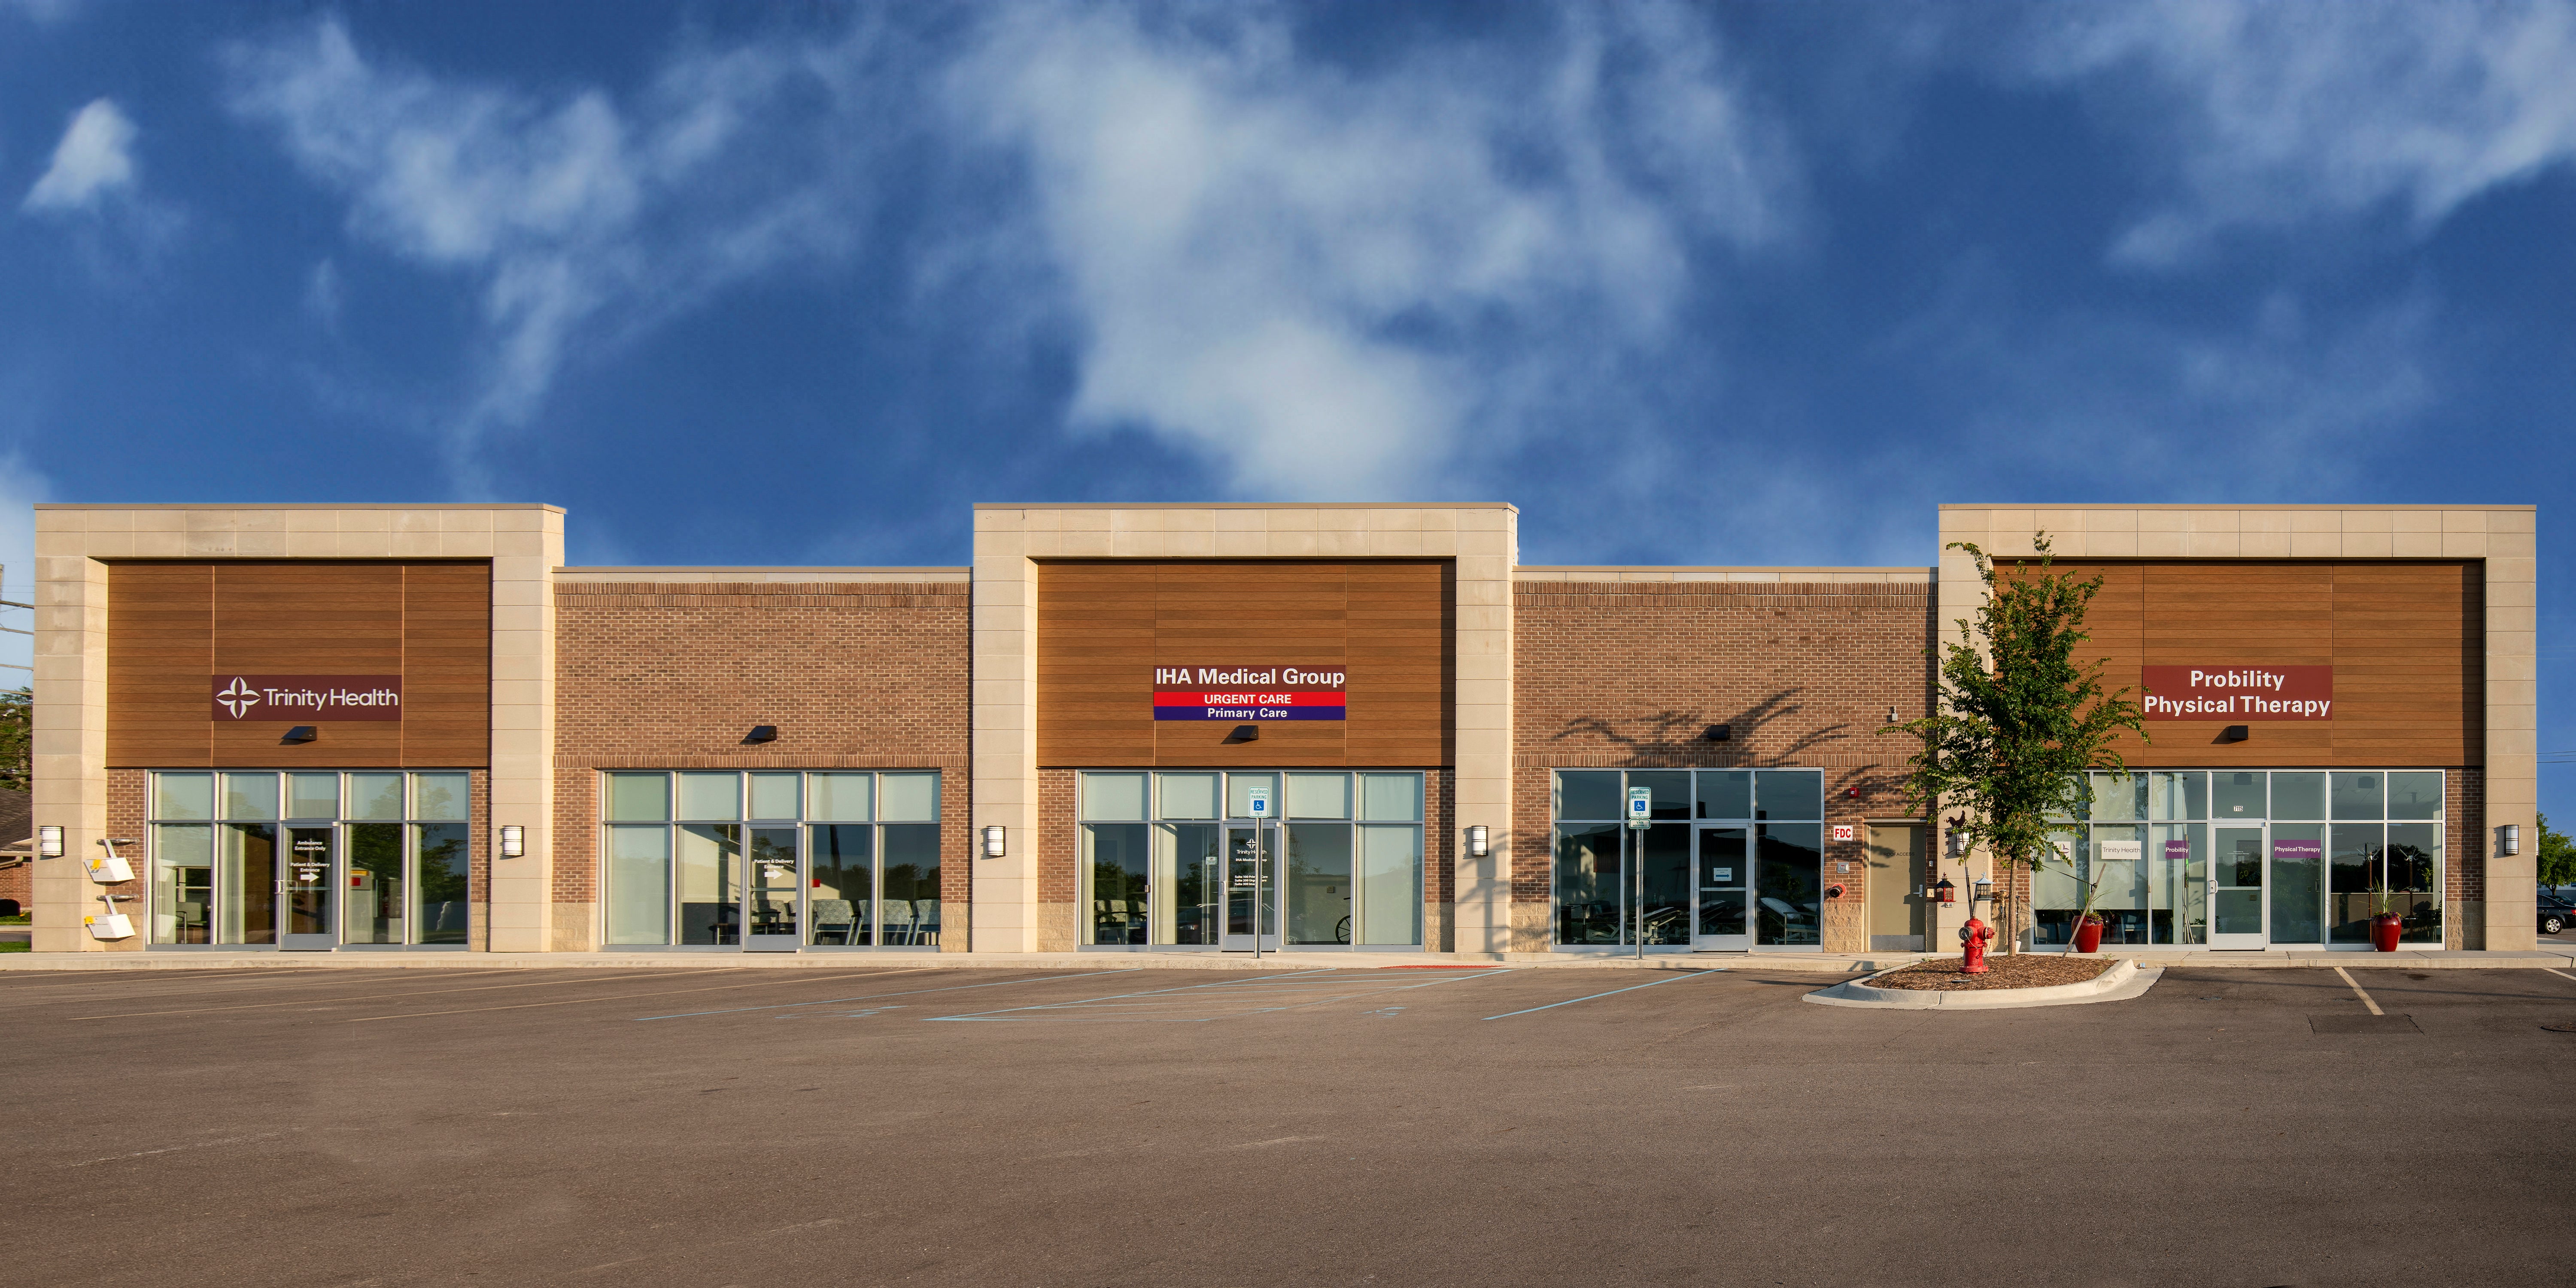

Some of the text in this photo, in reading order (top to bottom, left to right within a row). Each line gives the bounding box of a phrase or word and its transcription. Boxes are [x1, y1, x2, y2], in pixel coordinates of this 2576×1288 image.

[1156, 668, 1345, 688] IHA Medical Group
[2190, 670, 2285, 691] Probility
[263, 688, 398, 711] Trinity Health
[1204, 694, 1292, 704] URGENT CARE
[2145, 696, 2331, 717] Physical Therapy
[1207, 708, 1288, 720] Primary Care
[1835, 828, 1851, 838] FDC
